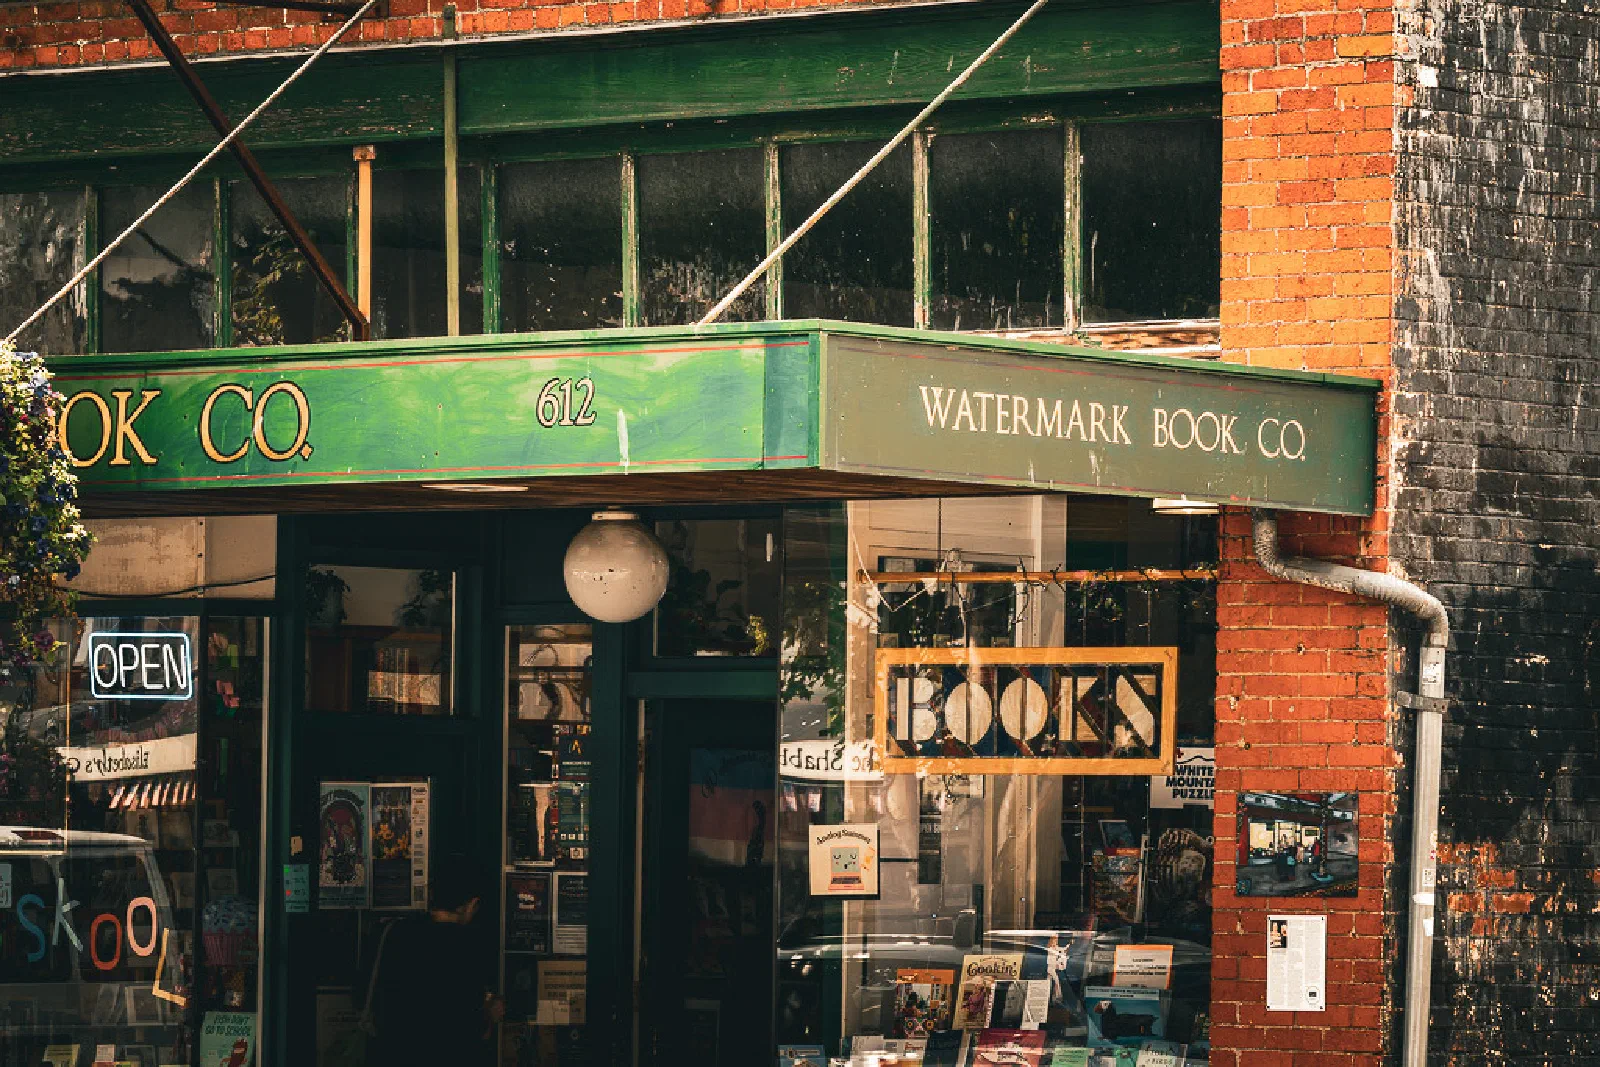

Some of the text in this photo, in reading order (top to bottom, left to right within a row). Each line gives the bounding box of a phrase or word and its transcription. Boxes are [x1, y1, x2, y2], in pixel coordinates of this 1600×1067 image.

[536, 377, 597, 428] 612
[919, 385, 1132, 445] WATERMARK
[1153, 408, 1242, 454] BOOK
[93, 643, 188, 690] OPEN
[896, 673, 1156, 747] BOOKS
[1176, 765, 1214, 775] WHITE
